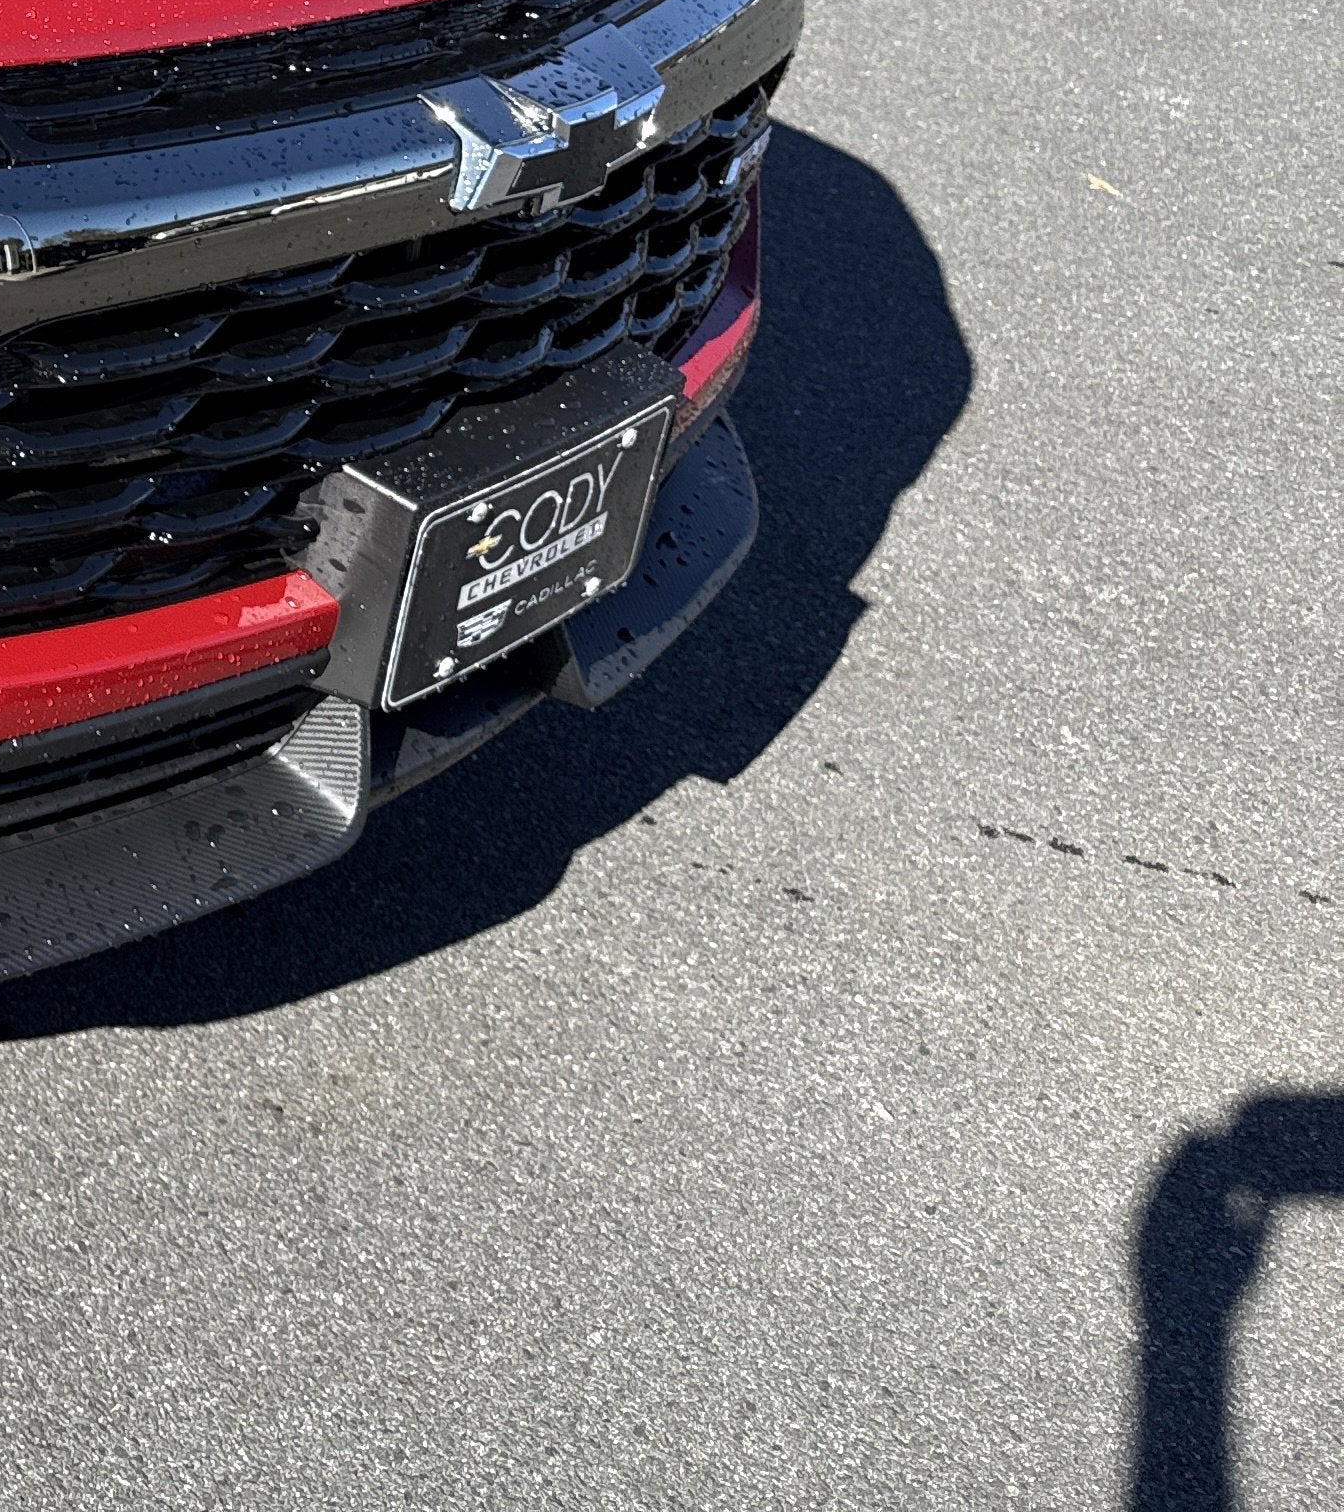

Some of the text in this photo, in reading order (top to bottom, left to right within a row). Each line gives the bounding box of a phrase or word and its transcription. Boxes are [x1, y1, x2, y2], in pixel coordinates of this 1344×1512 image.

[478, 451, 623, 570] CODY
[466, 518, 604, 602] CHEVROLET
[514, 559, 597, 616] CADILLAC
